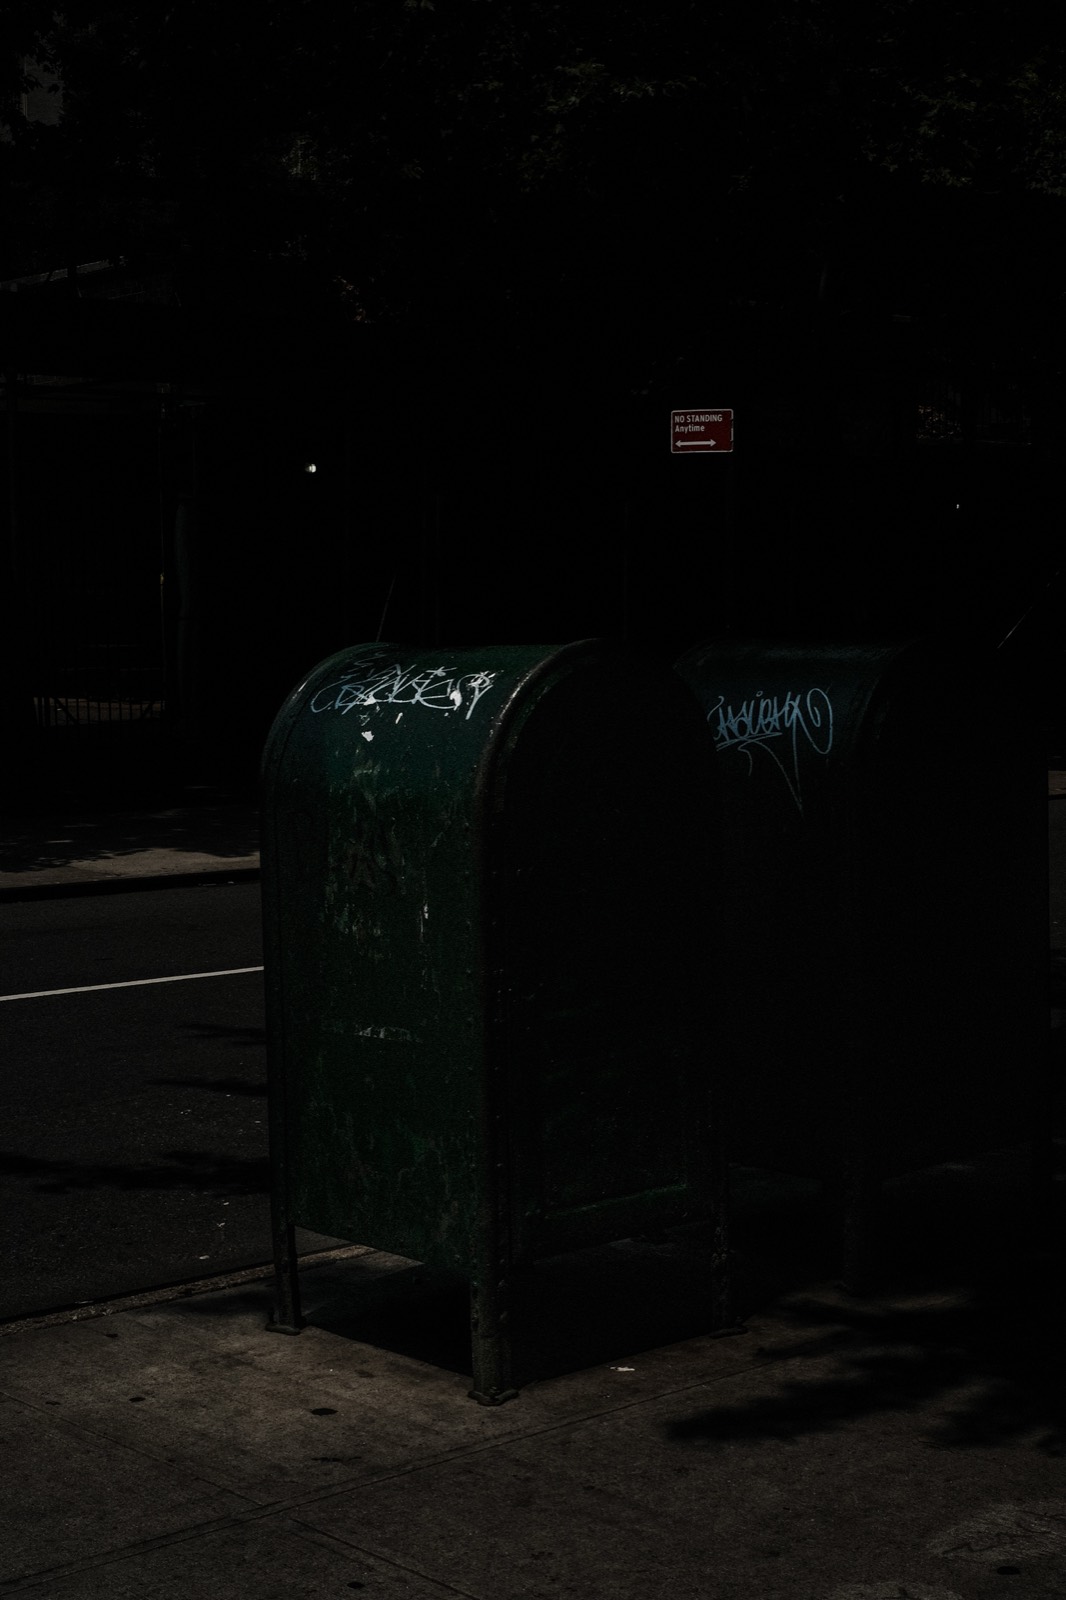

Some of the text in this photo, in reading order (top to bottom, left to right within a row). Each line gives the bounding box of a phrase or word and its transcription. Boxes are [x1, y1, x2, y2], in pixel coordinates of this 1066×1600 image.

[674, 414, 723, 423] NO STANDING
[674, 424, 705, 434] Anytime
